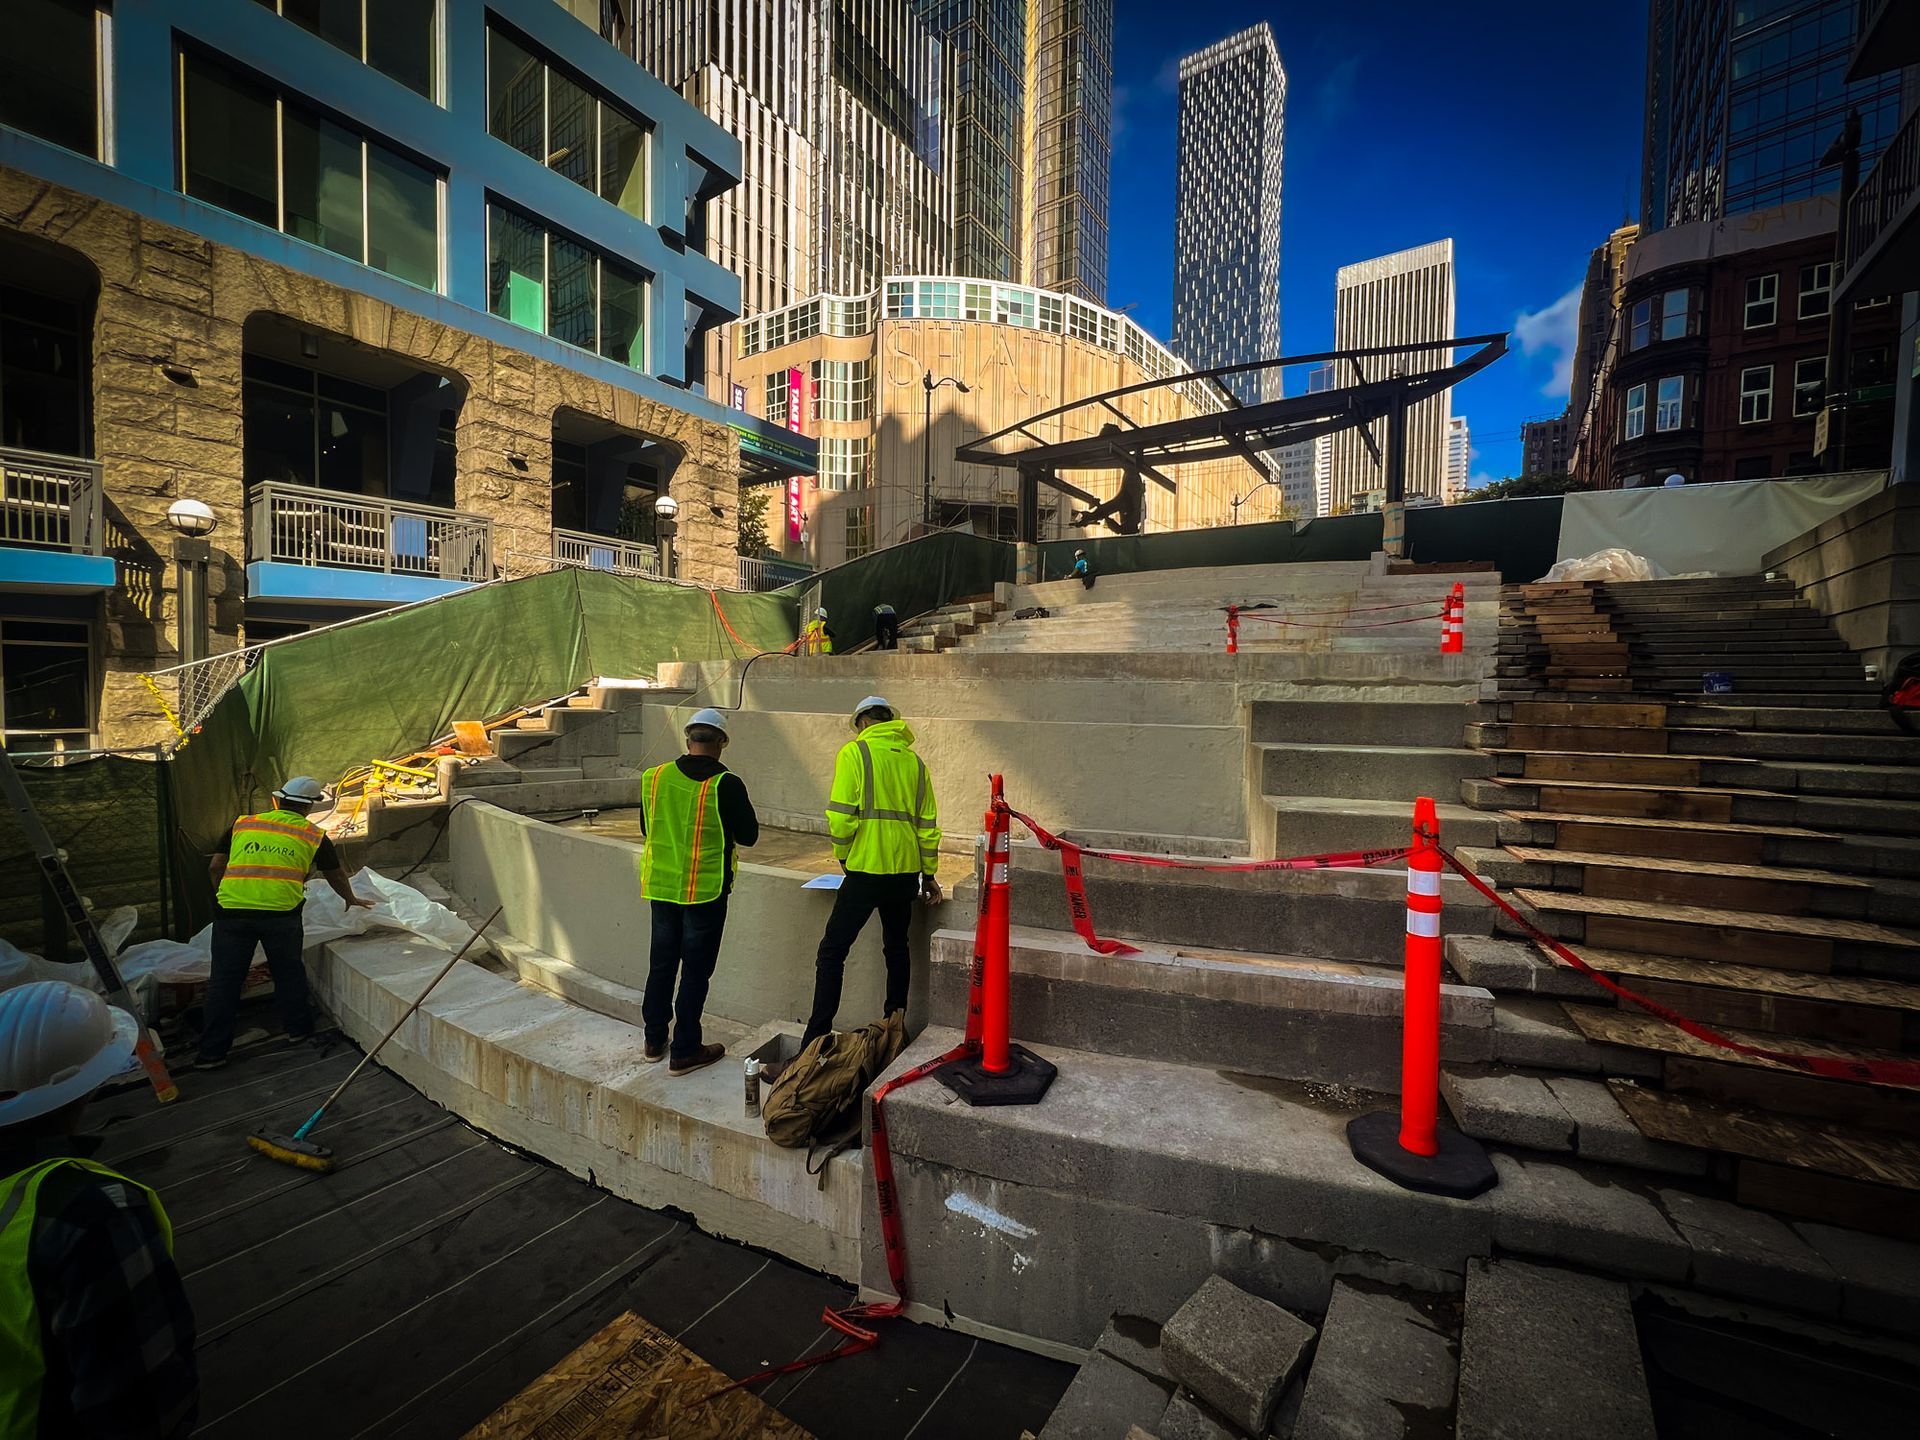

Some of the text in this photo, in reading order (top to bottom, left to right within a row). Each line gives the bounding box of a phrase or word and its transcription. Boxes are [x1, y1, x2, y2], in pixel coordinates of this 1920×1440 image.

[791, 388, 800, 423] TAKE
[790, 495, 799, 525] ART
[260, 845, 295, 857] AVARA
[1069, 892, 1087, 919] DANGER
